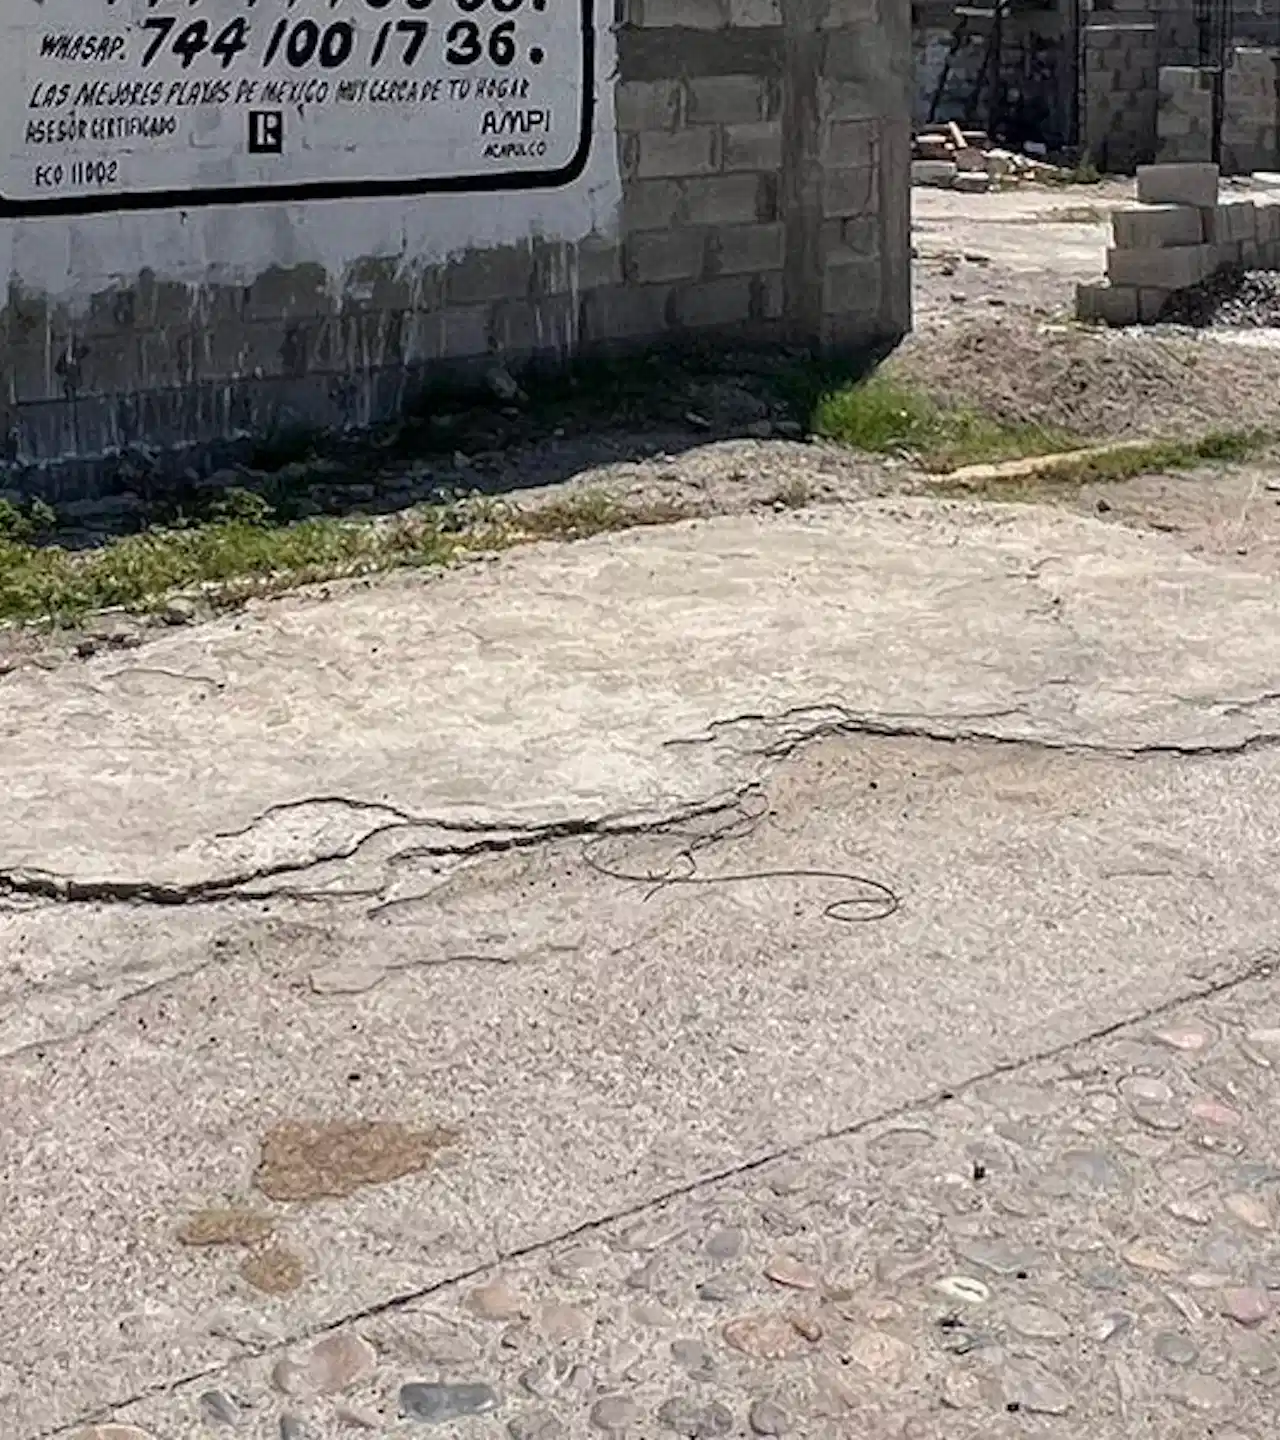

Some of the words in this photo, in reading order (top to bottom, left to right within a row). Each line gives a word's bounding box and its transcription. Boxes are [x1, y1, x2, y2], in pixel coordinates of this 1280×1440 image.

[140, 17, 250, 69] 744
[263, 18, 356, 68] 100
[371, 20, 430, 67] 17
[28, 82, 71, 108] LAS
[73, 81, 165, 107] MEJORES
[165, 79, 232, 106] PLAYAS
[234, 79, 259, 104] DE
[369, 78, 419, 103] CERCA
[419, 78, 443, 102] DE
[447, 79, 471, 100] TU
[474, 78, 531, 100] HOGAR
[481, 109, 552, 135] AMPI
